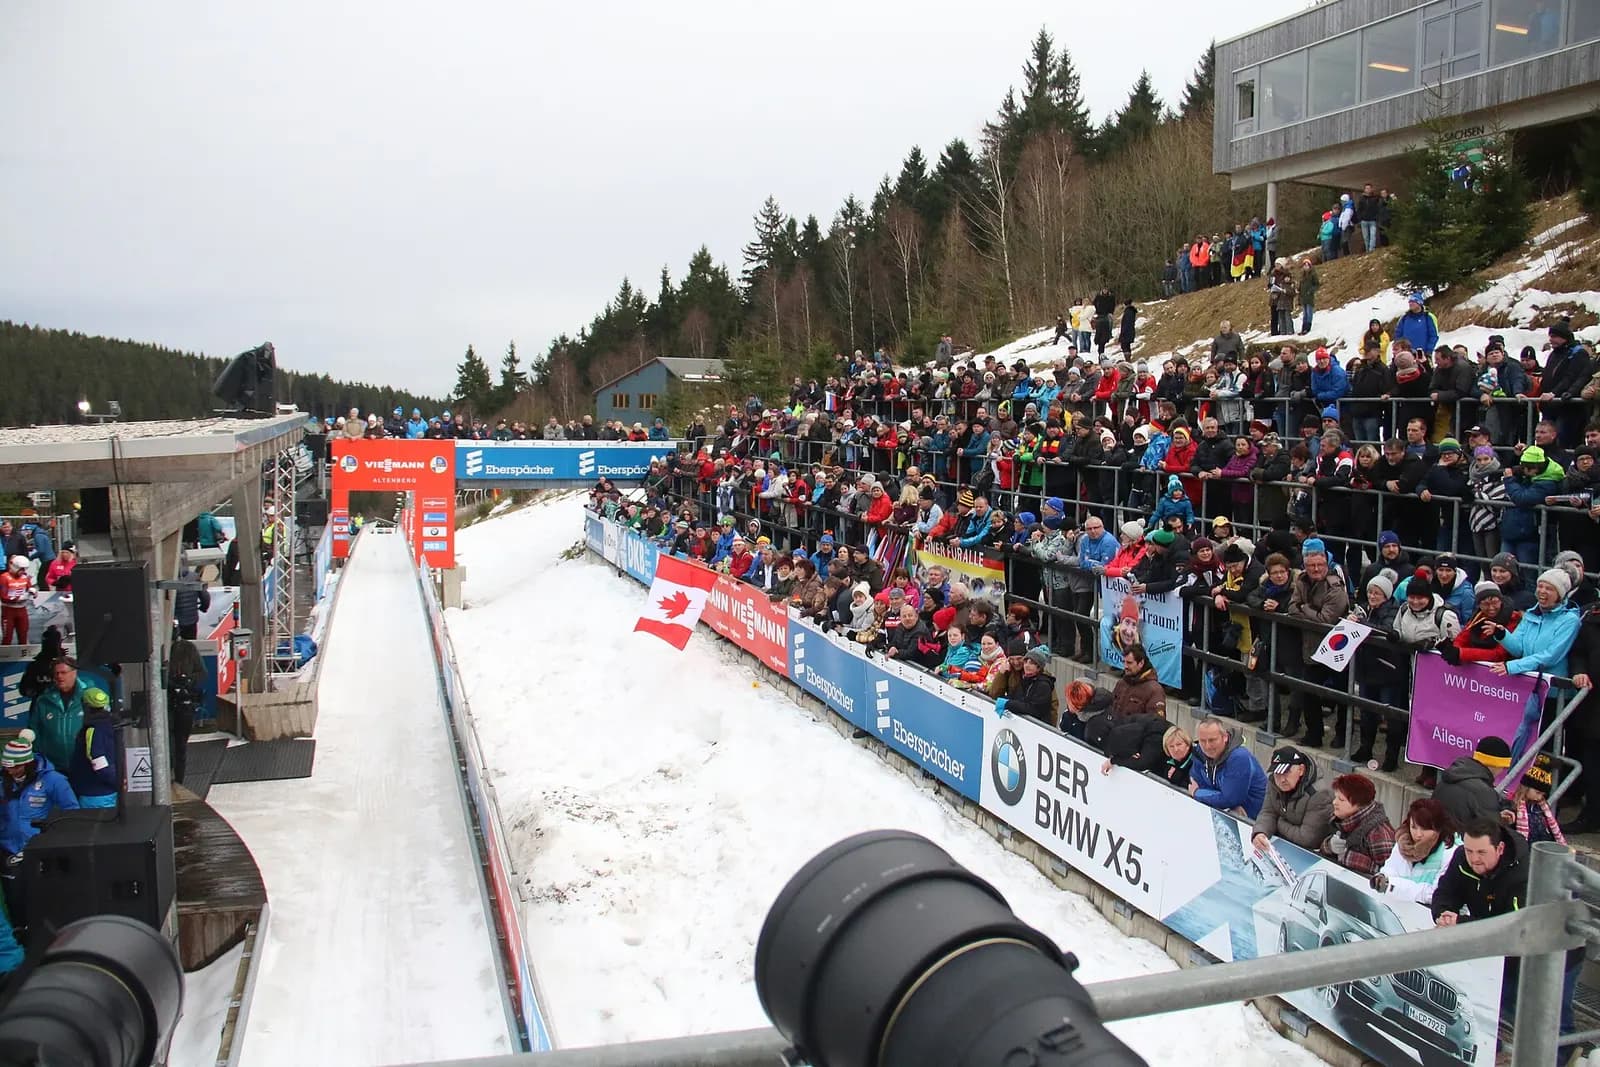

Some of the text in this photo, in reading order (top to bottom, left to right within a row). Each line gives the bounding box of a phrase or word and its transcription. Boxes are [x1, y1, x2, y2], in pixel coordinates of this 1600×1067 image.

[485, 464, 554, 476] Eberspächer
[598, 465, 649, 476] Eberspäc
[627, 535, 645, 575] DKB
[924, 539, 946, 557] EINER
[962, 549, 984, 567] ALLE
[1106, 576, 1129, 594] Lebe
[1140, 607, 1179, 632] Traum!
[806, 665, 854, 713] Eberspächer
[1444, 672, 1519, 703] WW Dresden
[1474, 711, 1486, 723] für
[893, 719, 964, 781] Eberspächer
[1432, 726, 1473, 751] Aileen
[1037, 743, 1089, 805] DER
[1035, 789, 1149, 893] BMW X5.
